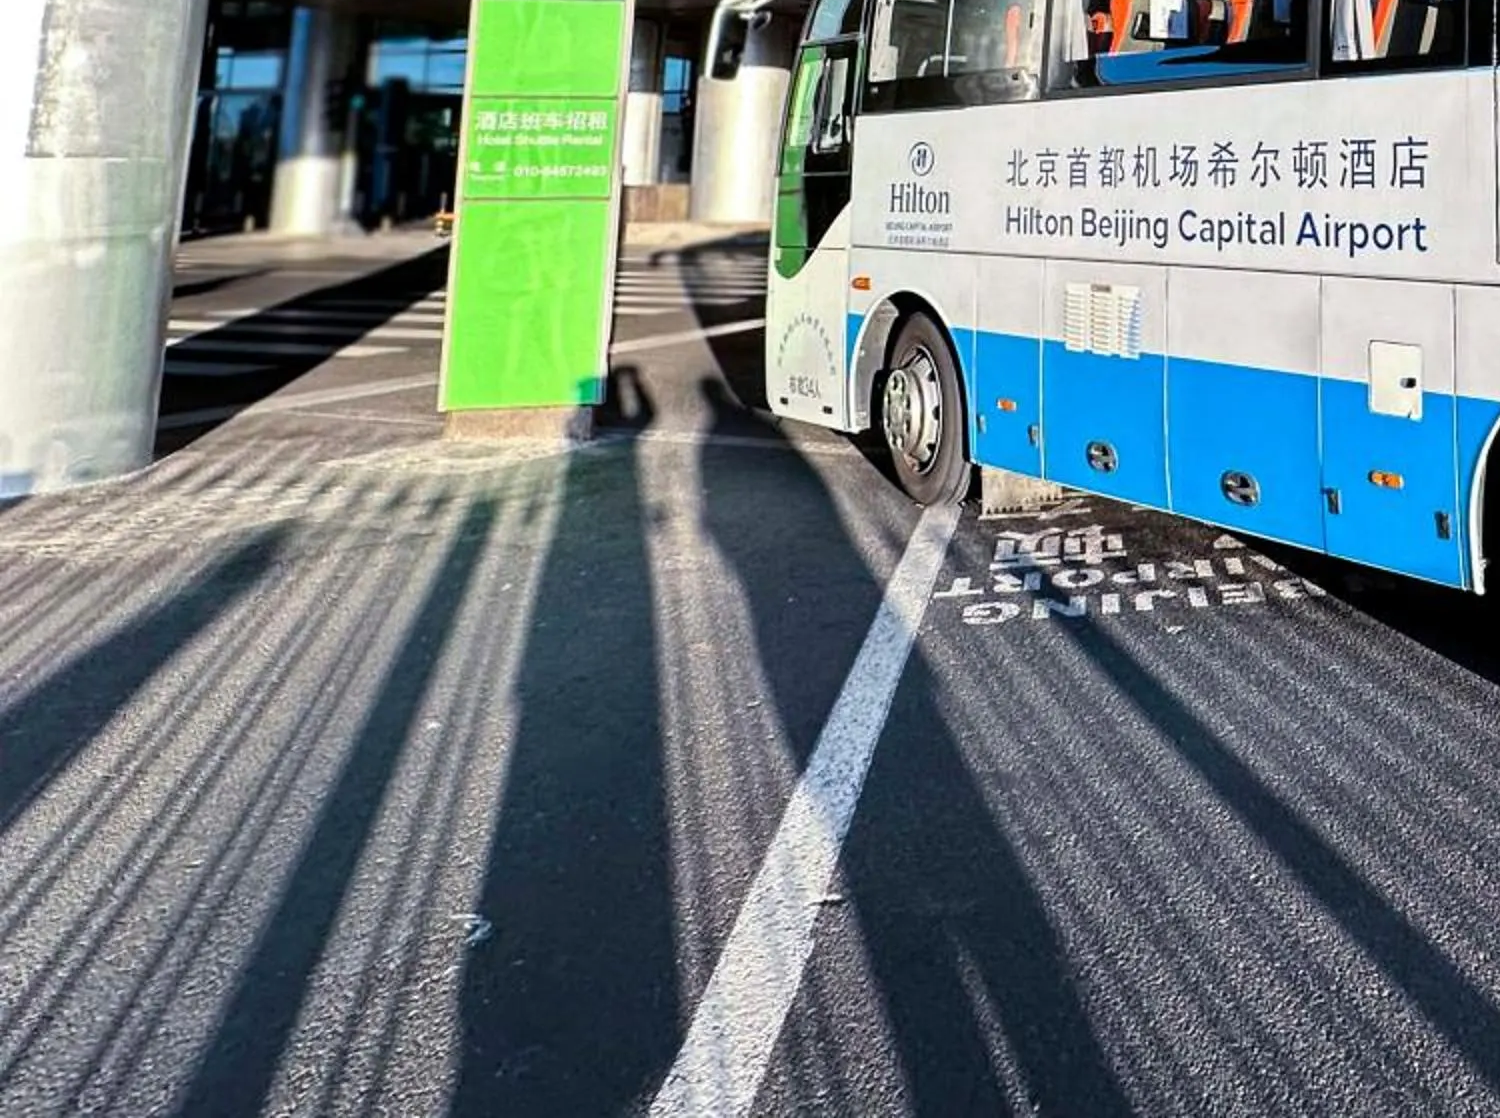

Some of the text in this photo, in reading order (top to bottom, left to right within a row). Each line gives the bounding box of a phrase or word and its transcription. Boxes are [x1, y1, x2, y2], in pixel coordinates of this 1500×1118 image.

[1006, 136, 1428, 189] 北京首都机场希尔顿酒店
[889, 181, 949, 214] Hilton
[1006, 206, 1428, 258] Hilton Beijing Capital Airport
[962, 576, 1327, 625] BEIJING
